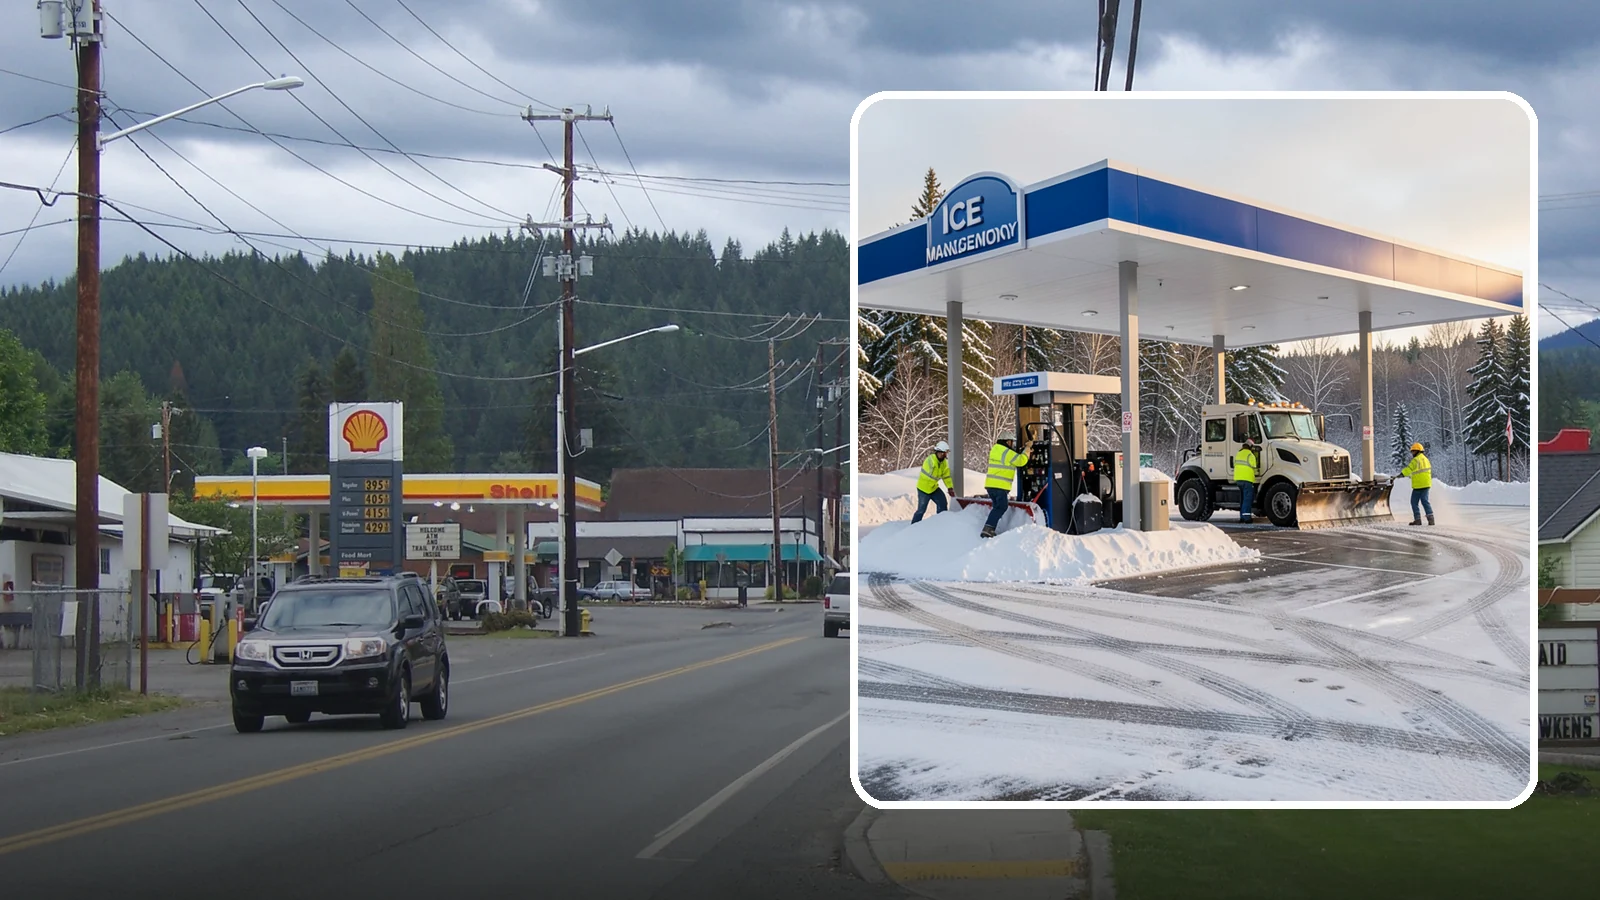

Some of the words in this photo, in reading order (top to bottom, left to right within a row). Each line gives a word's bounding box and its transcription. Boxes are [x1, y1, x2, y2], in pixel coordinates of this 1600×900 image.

[942, 195, 983, 235] ICE
[366, 479, 383, 490] 395
[489, 484, 547, 499] Shell
[366, 494, 383, 504] 405
[366, 508, 383, 518] 415
[366, 522, 383, 532] 429
